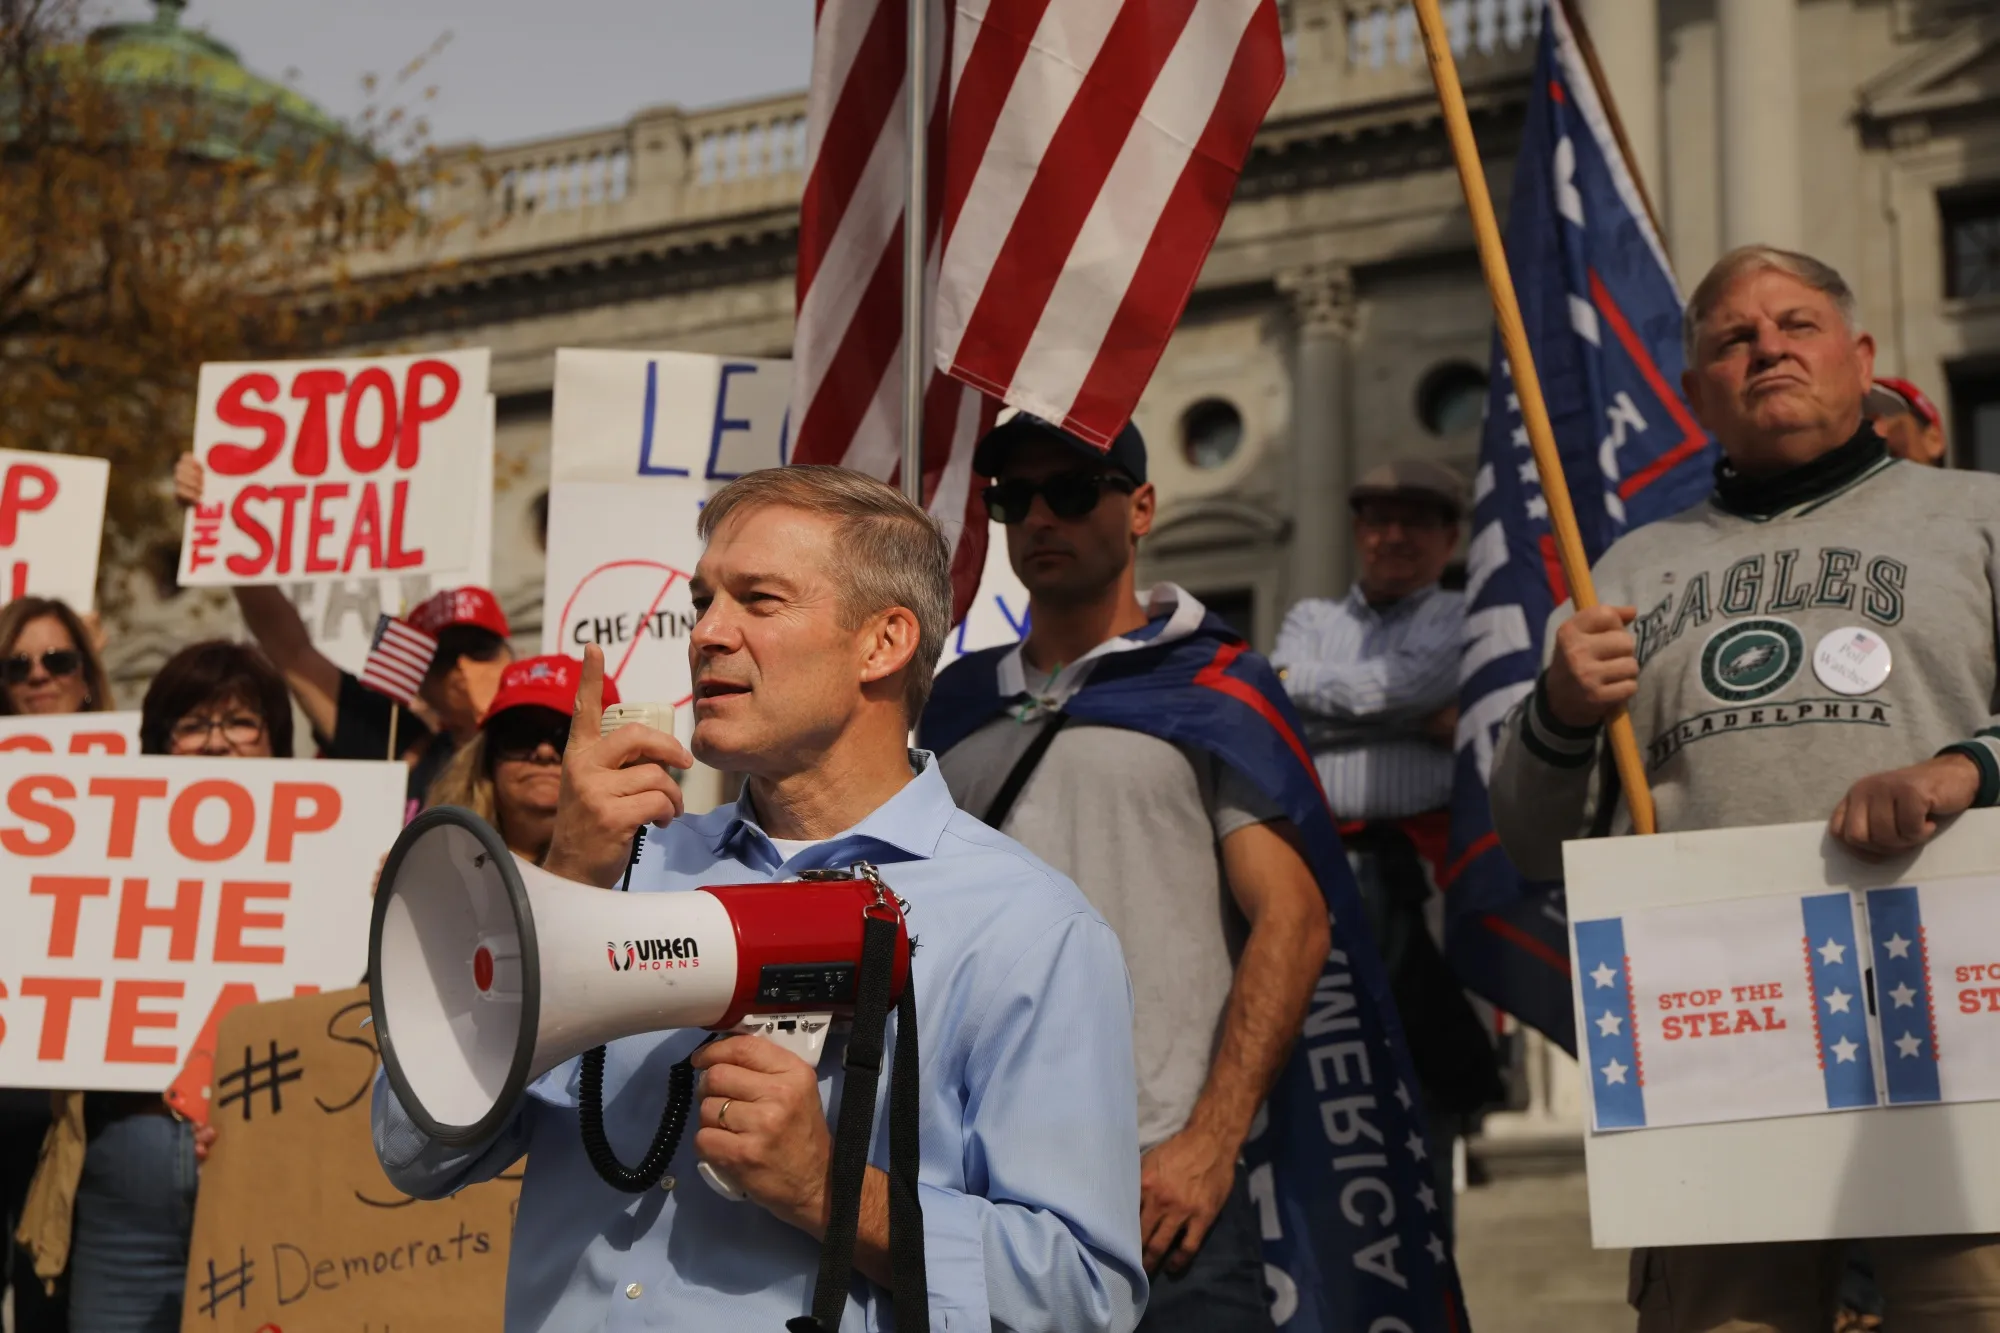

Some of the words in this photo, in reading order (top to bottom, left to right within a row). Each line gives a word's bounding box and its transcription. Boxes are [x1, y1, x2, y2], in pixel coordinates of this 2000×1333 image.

[207, 359, 460, 476] STOP
[190, 501, 223, 575] THE
[226, 480, 424, 577] STEAL
[1634, 547, 1907, 672] EAGLES
[0, 774, 342, 863] STOP
[29, 875, 291, 964] THE
[638, 959, 700, 971] HORNS
[1658, 988, 1722, 1010] STOP
[1731, 982, 1784, 1003] THE
[1662, 1006, 1787, 1041] STEAL
